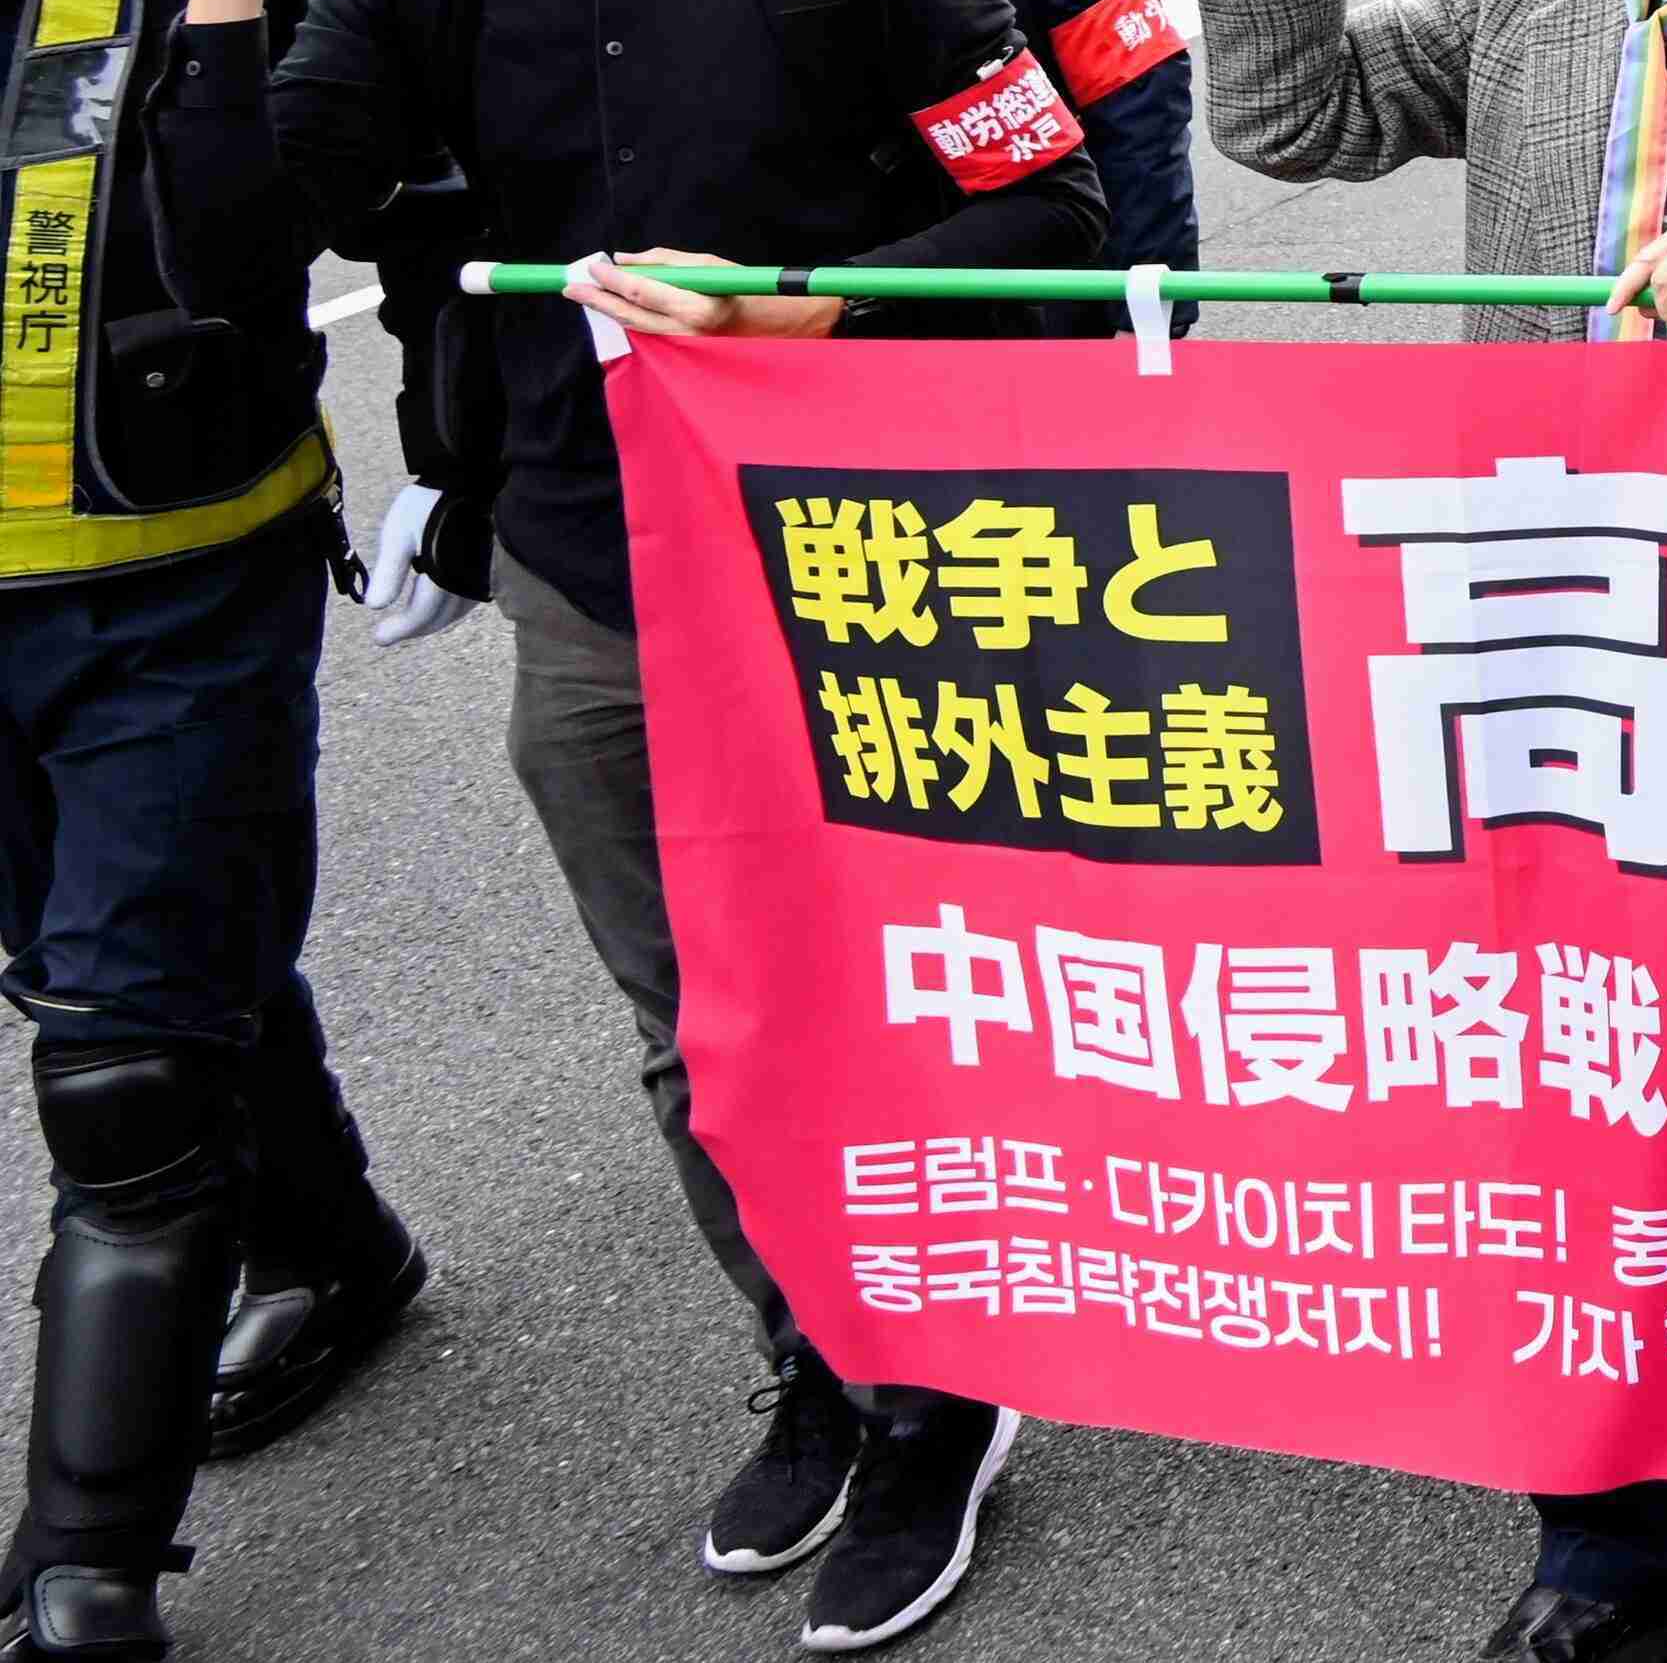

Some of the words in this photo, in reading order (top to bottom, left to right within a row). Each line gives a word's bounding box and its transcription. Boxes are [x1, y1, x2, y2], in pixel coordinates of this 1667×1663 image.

[1004, 112, 1061, 163] 水戸
[17, 209, 77, 353] 警視庁
[774, 496, 1229, 650] 戦争と
[821, 671, 1286, 833] 排外主義
[1400, 1180, 1568, 1262] 타도!
[849, 1236, 1443, 1360] 중국침략전쟁저지!
[1512, 1289, 1644, 1385] 가자
